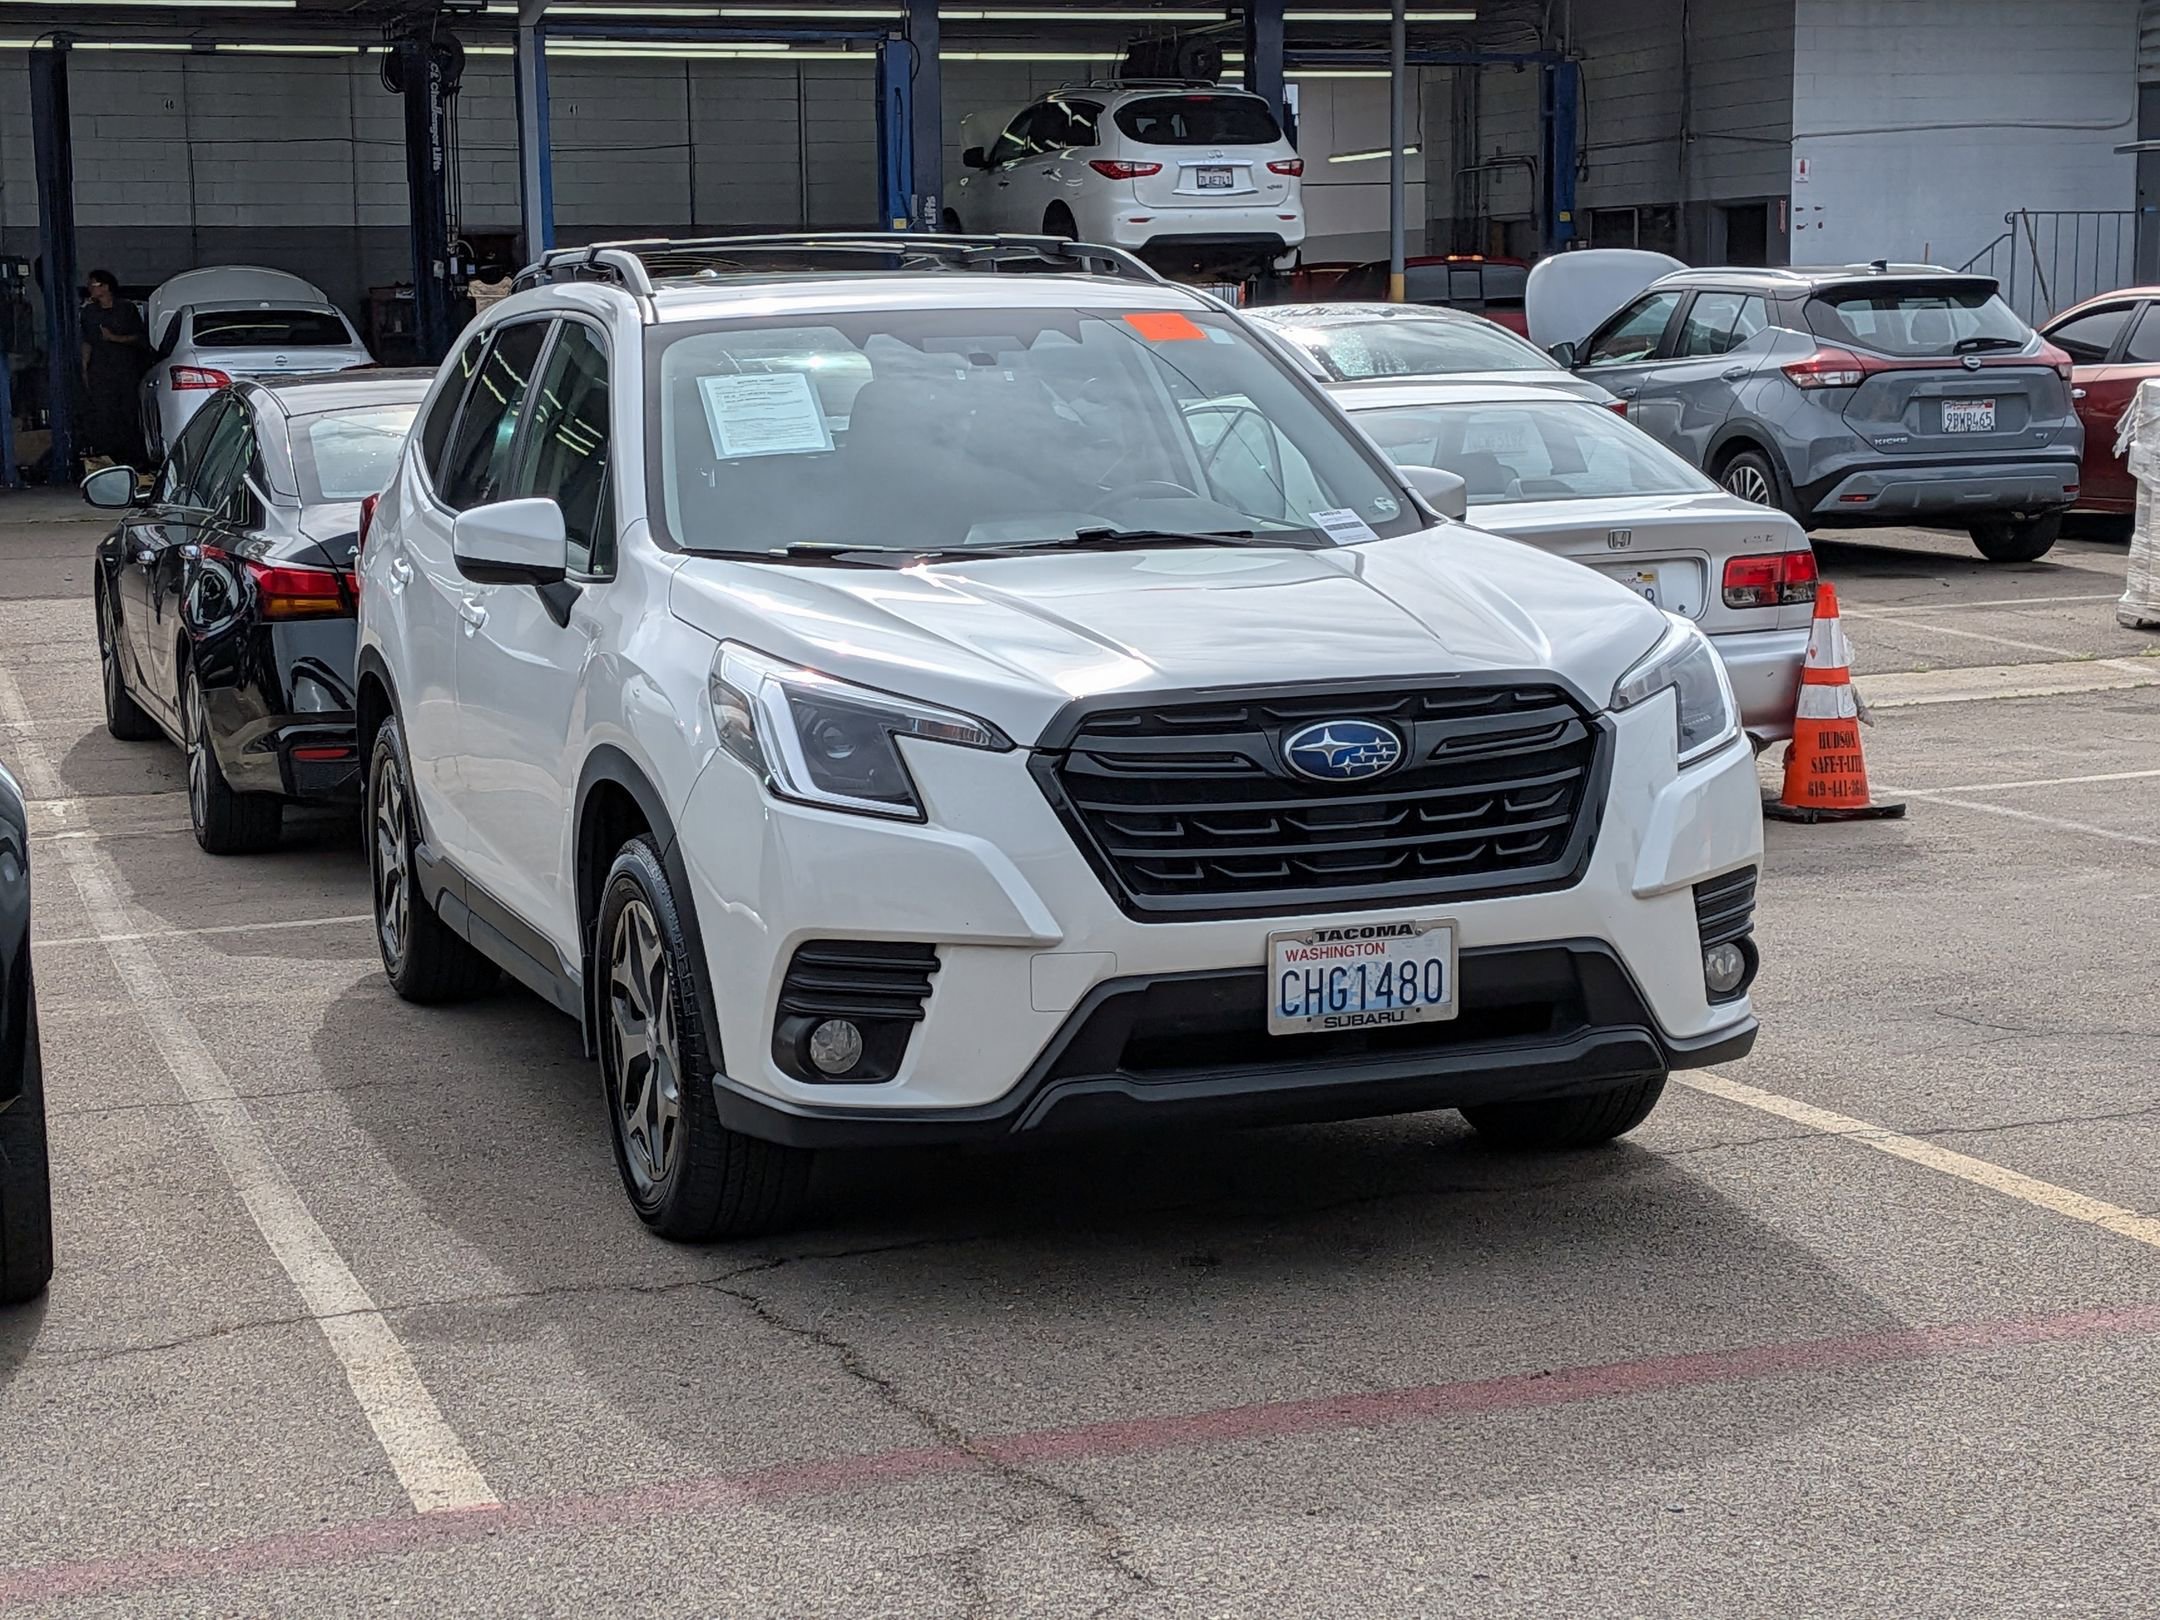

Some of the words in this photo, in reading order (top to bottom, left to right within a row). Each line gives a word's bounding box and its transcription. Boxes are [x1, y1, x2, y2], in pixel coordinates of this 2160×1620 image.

[432, 147, 442, 172] Lifts
[924, 195, 937, 225] Lifts
[1946, 411, 1993, 429] 9BWB465
[1818, 731, 1857, 749] HUDSON
[1315, 923, 1414, 942] TACOMA
[1285, 942, 1386, 962] WASHINGTON
[1281, 957, 1443, 1016] CHG1480
[1323, 1010, 1406, 1029] SUBARU
